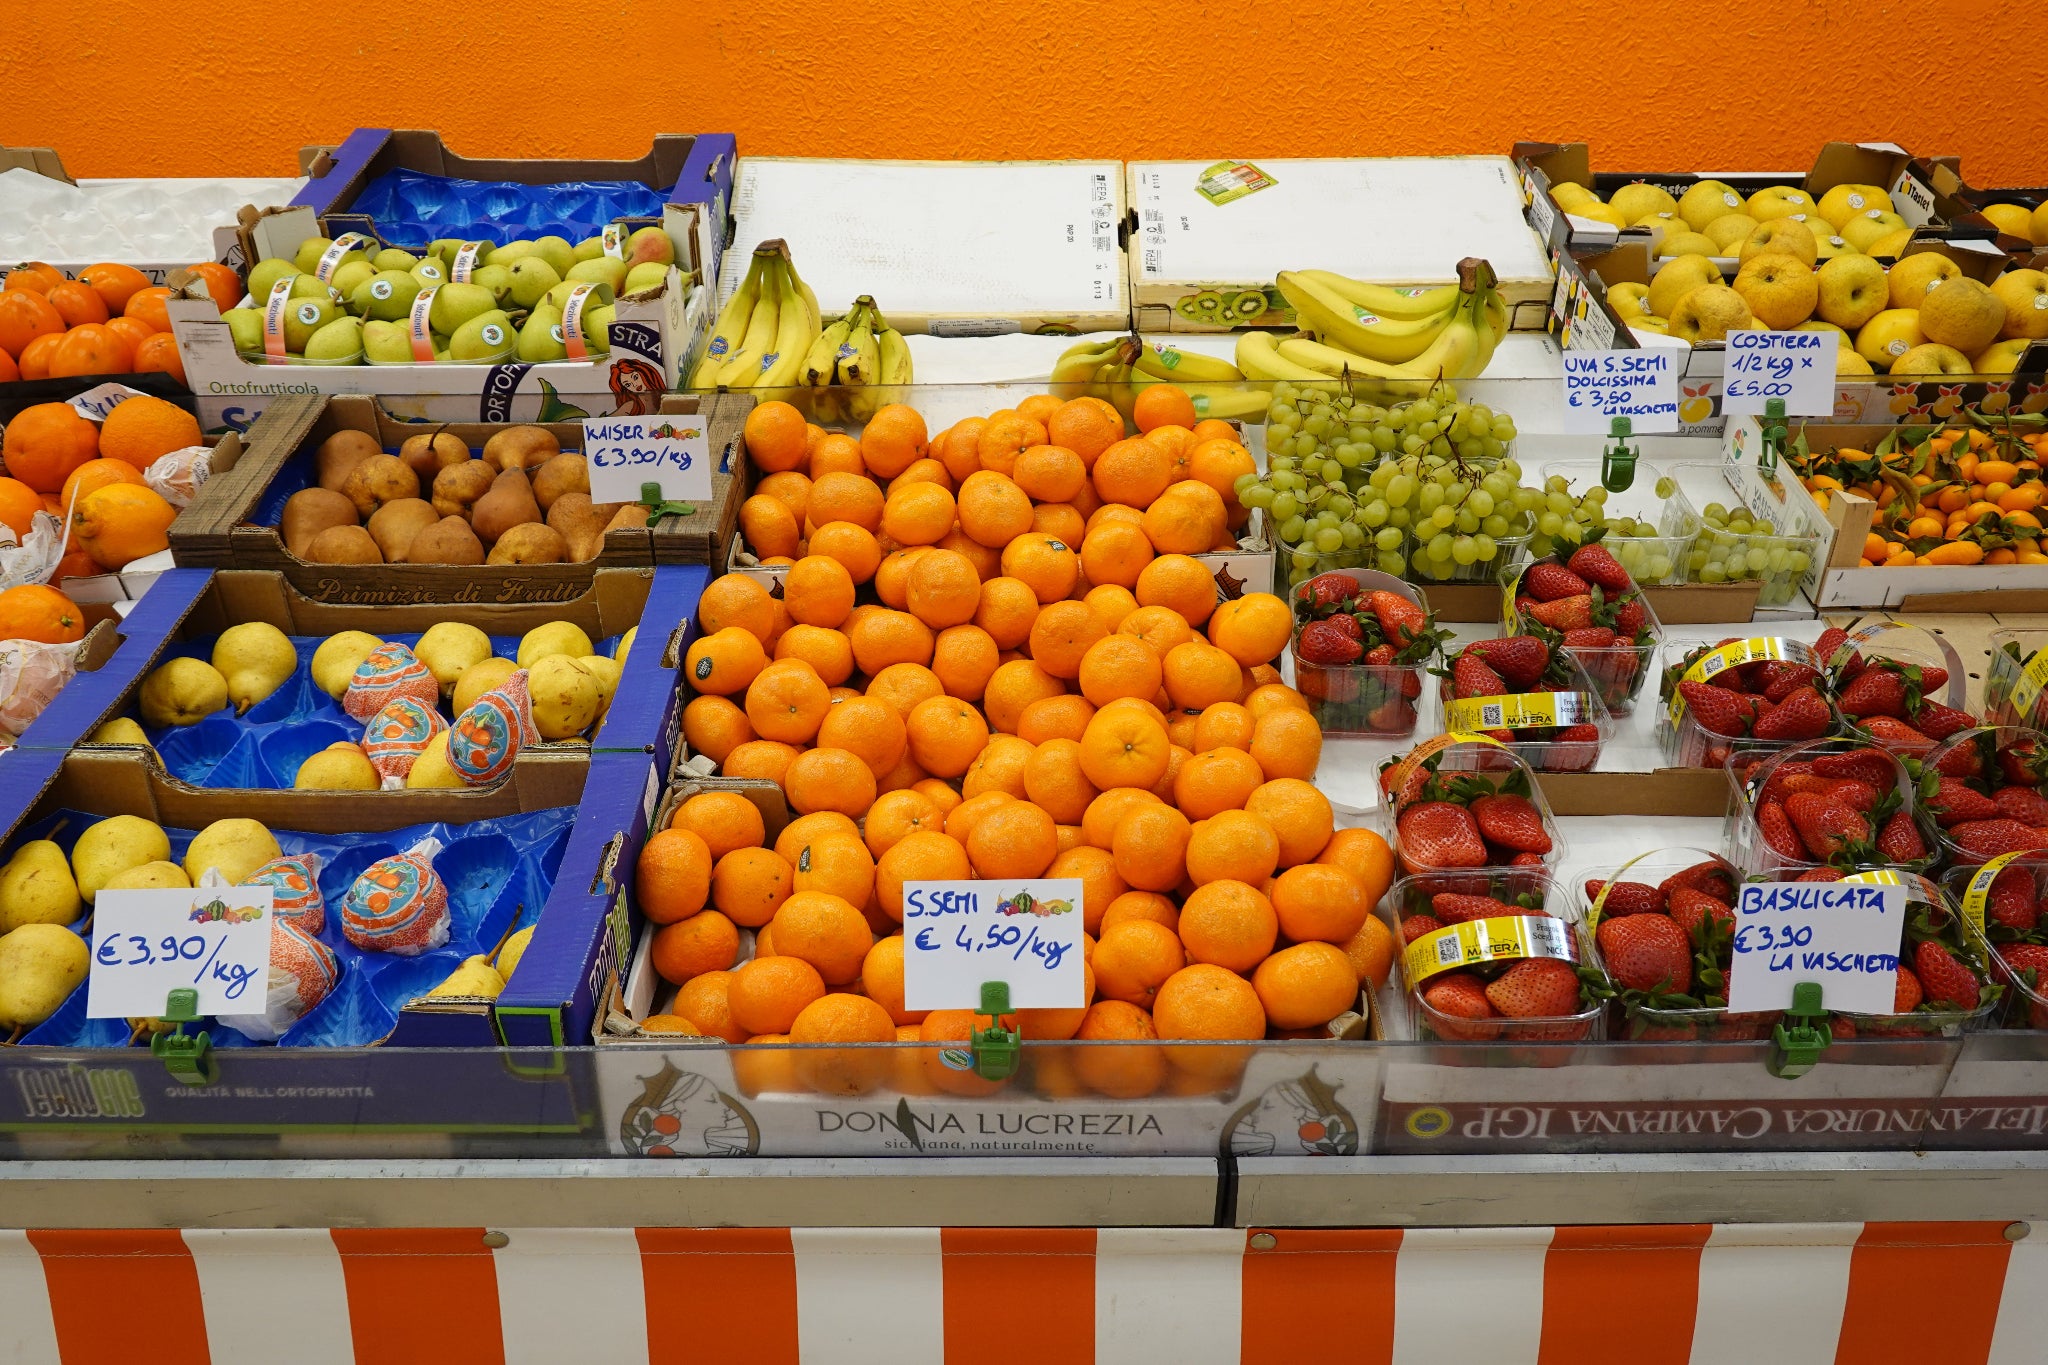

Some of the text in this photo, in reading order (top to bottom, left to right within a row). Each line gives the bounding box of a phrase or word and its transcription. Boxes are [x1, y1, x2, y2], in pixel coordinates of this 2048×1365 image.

[1096, 182, 1107, 201] FEPA
[1911, 186, 1930, 212] Tastet
[1732, 333, 1821, 349] COSTIERA
[1565, 357, 1598, 373] UVA
[209, 381, 319, 395] Ortofrutticola
[1568, 375, 1657, 388] DOLCISSIMA
[1603, 406, 1617, 415] LA
[585, 424, 644, 441] KAISER
[1688, 425, 1724, 435] pomme
[314, 578, 437, 603] Primizie
[453, 581, 482, 602] di
[1507, 715, 1552, 724] MATERA
[1742, 887, 1885, 914] BASILICATA
[1769, 953, 1794, 971] LA
[815, 1109, 1164, 1136] DONNA LUCREZIA
[1461, 1105, 1555, 1139] IGP
[971, 1138, 1095, 1151] naturalmente
